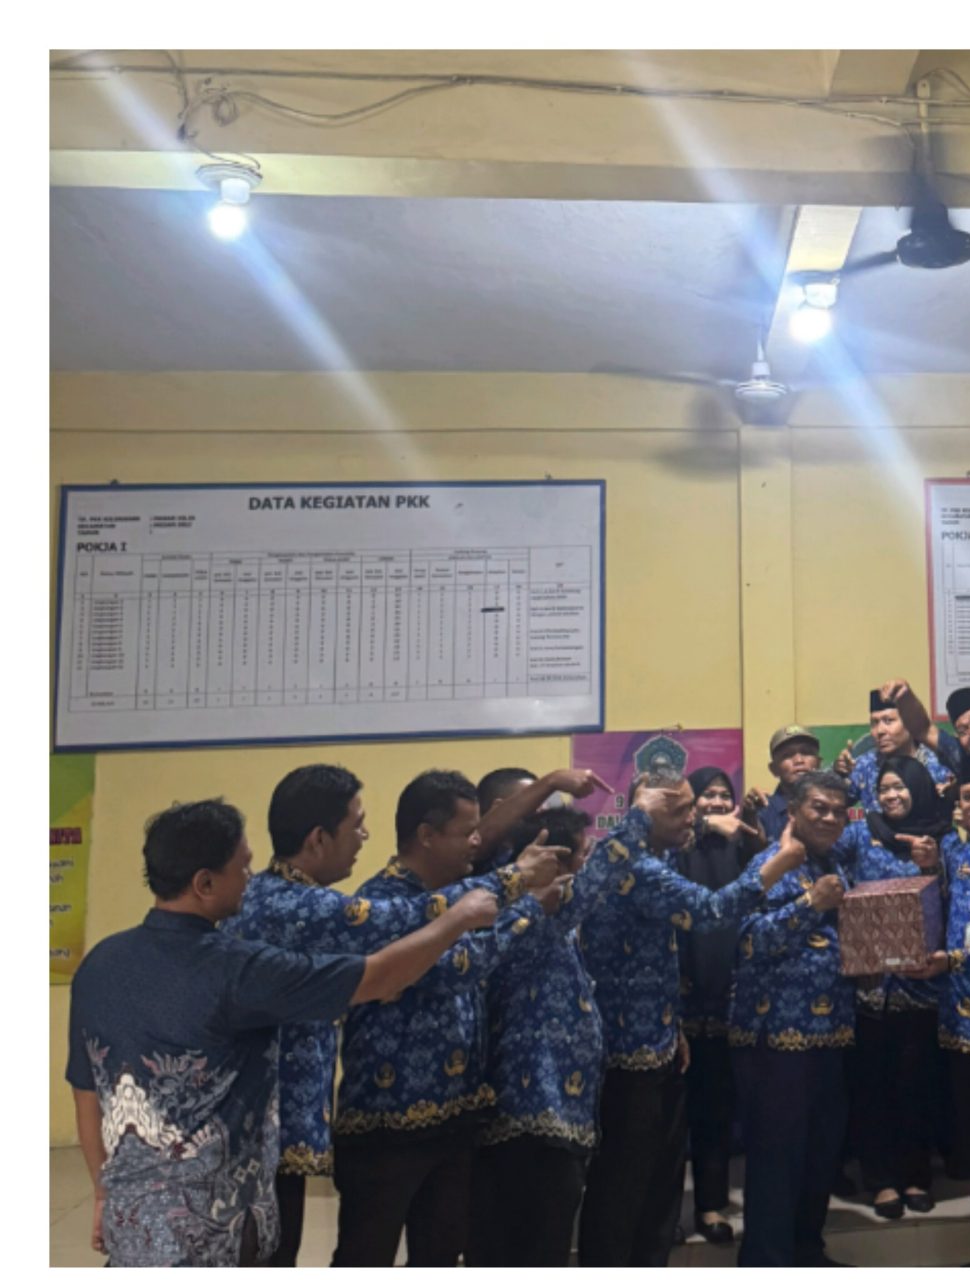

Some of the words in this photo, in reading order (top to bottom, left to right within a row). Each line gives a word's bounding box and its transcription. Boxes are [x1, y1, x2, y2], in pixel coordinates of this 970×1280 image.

[248, 497, 296, 511] DATA
[300, 495, 390, 510] KEGIATAN
[396, 495, 431, 509] PKK
[77, 542, 118, 552] POKJA
